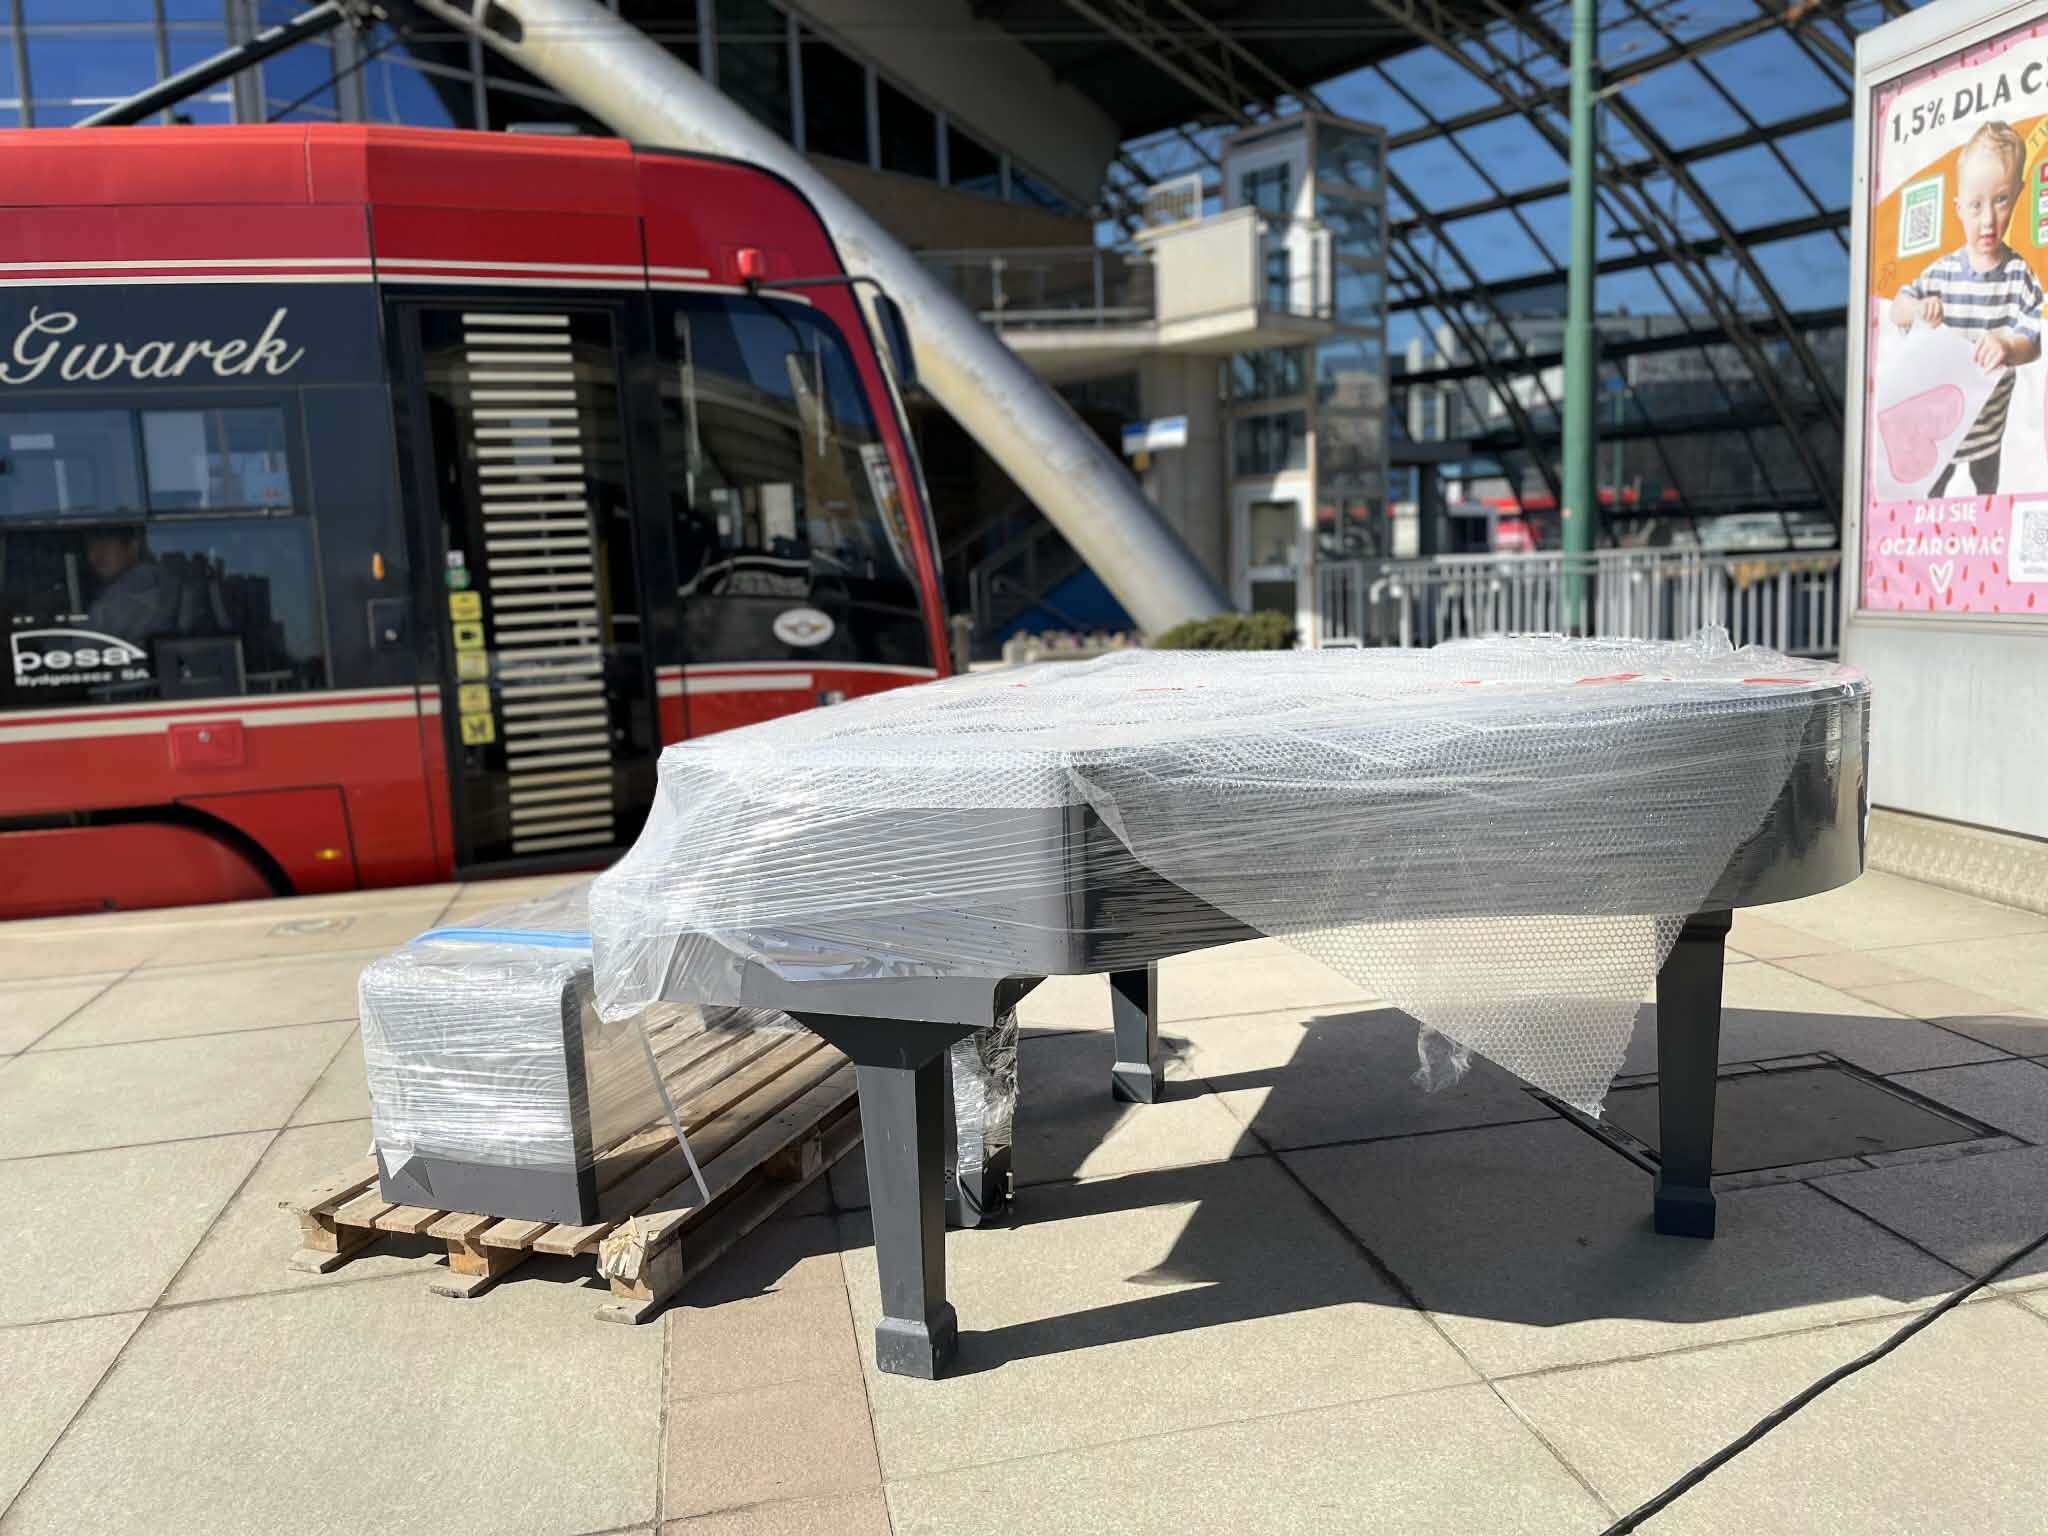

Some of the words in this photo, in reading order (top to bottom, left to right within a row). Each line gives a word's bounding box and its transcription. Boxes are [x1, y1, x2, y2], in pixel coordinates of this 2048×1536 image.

[1893, 97, 1945, 144] 1,5%
[1952, 73, 2013, 121] DLA
[2021, 57, 2048, 95] C
[0, 305, 305, 384] Gwarek
[1913, 504, 1945, 524] DAJ
[1879, 529, 2005, 556] OCZAROWAĆ
[13, 646, 132, 675] pesa
